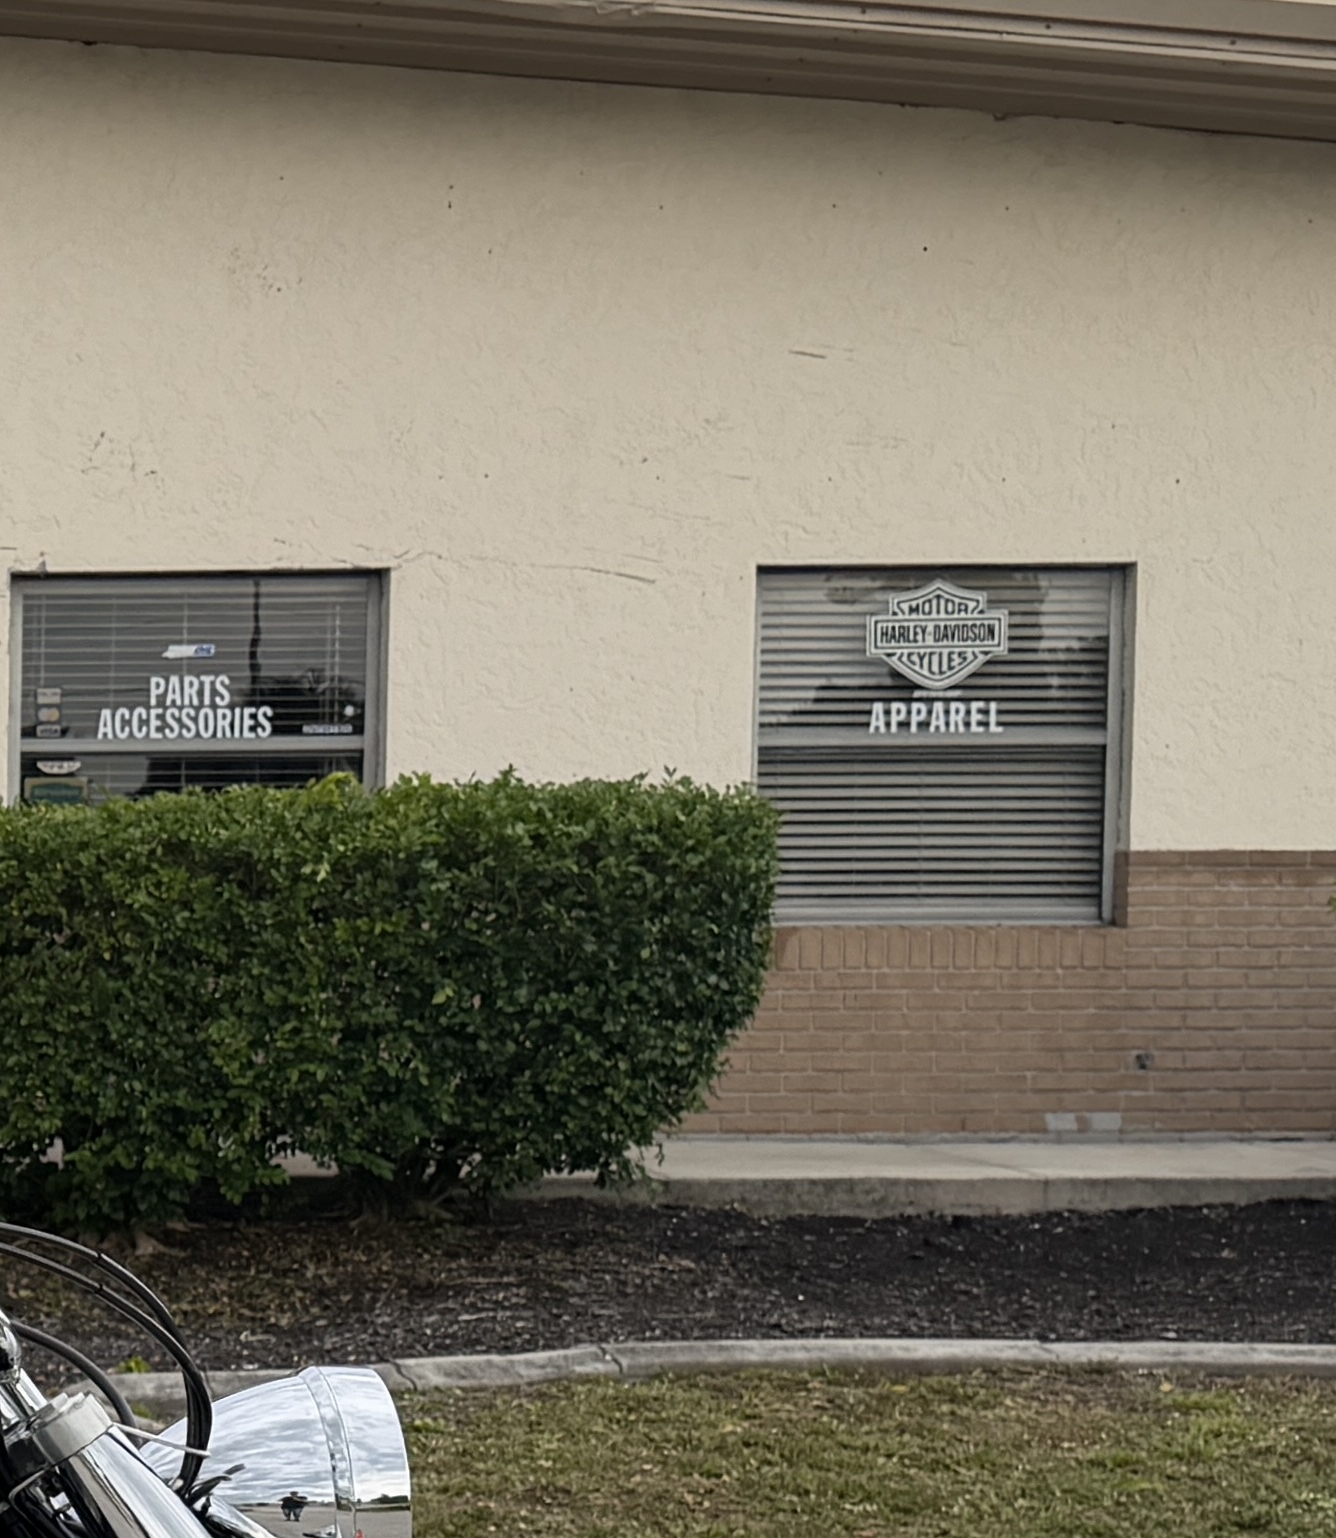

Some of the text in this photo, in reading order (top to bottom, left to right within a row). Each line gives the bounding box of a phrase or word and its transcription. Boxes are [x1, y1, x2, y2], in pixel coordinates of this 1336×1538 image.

[907, 593, 969, 616] MOTOR
[880, 622, 996, 644] HARLEY-DAVIDSON
[907, 650, 969, 676] CYCLES
[149, 674, 231, 707] PARTS
[97, 705, 274, 740] ACCESSORIES
[868, 701, 1004, 734] APPAREL
